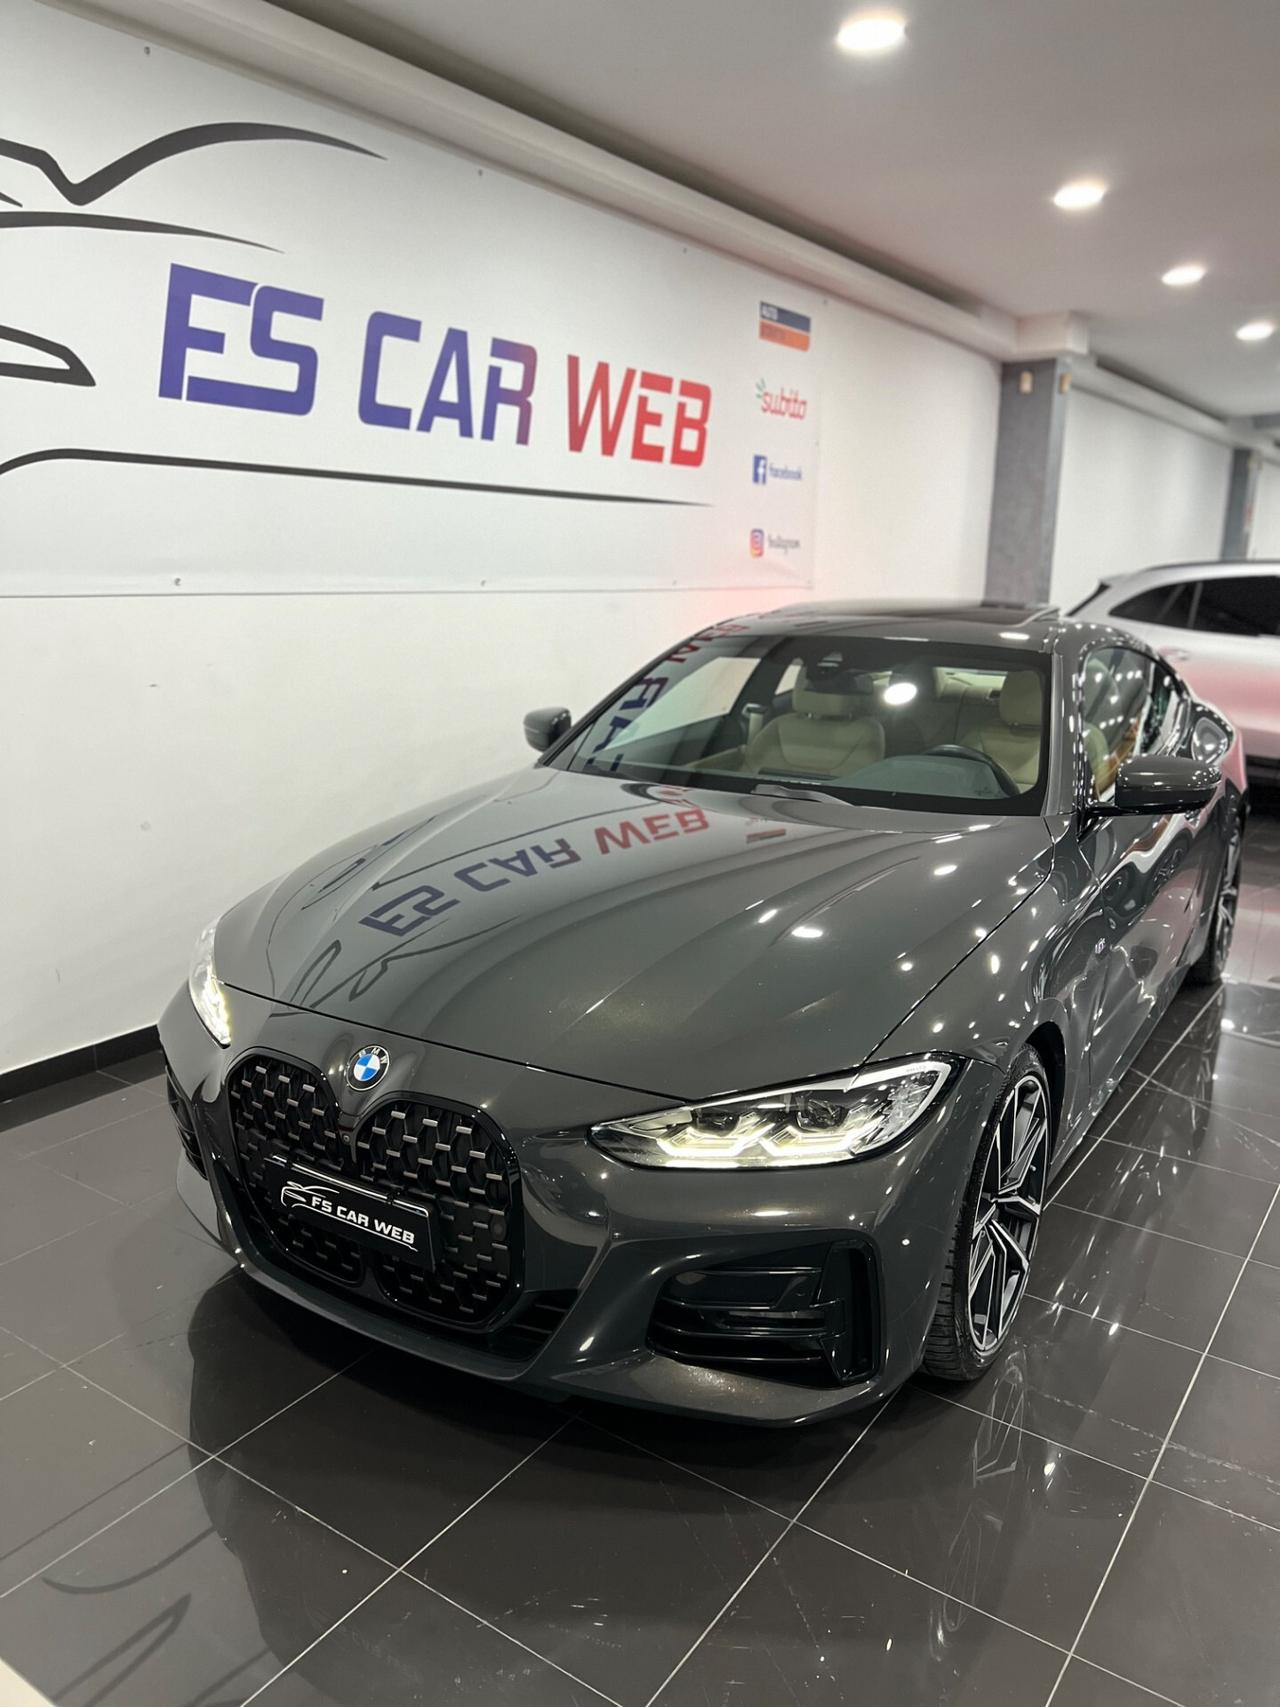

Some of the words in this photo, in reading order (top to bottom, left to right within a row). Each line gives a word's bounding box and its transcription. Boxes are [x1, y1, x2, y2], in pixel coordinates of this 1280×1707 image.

[358, 311, 538, 445] CAR
[566, 354, 711, 468] WEB
[311, 1196, 333, 1213] FS
[336, 1206, 369, 1228] CAR
[374, 1219, 415, 1245] WEB
